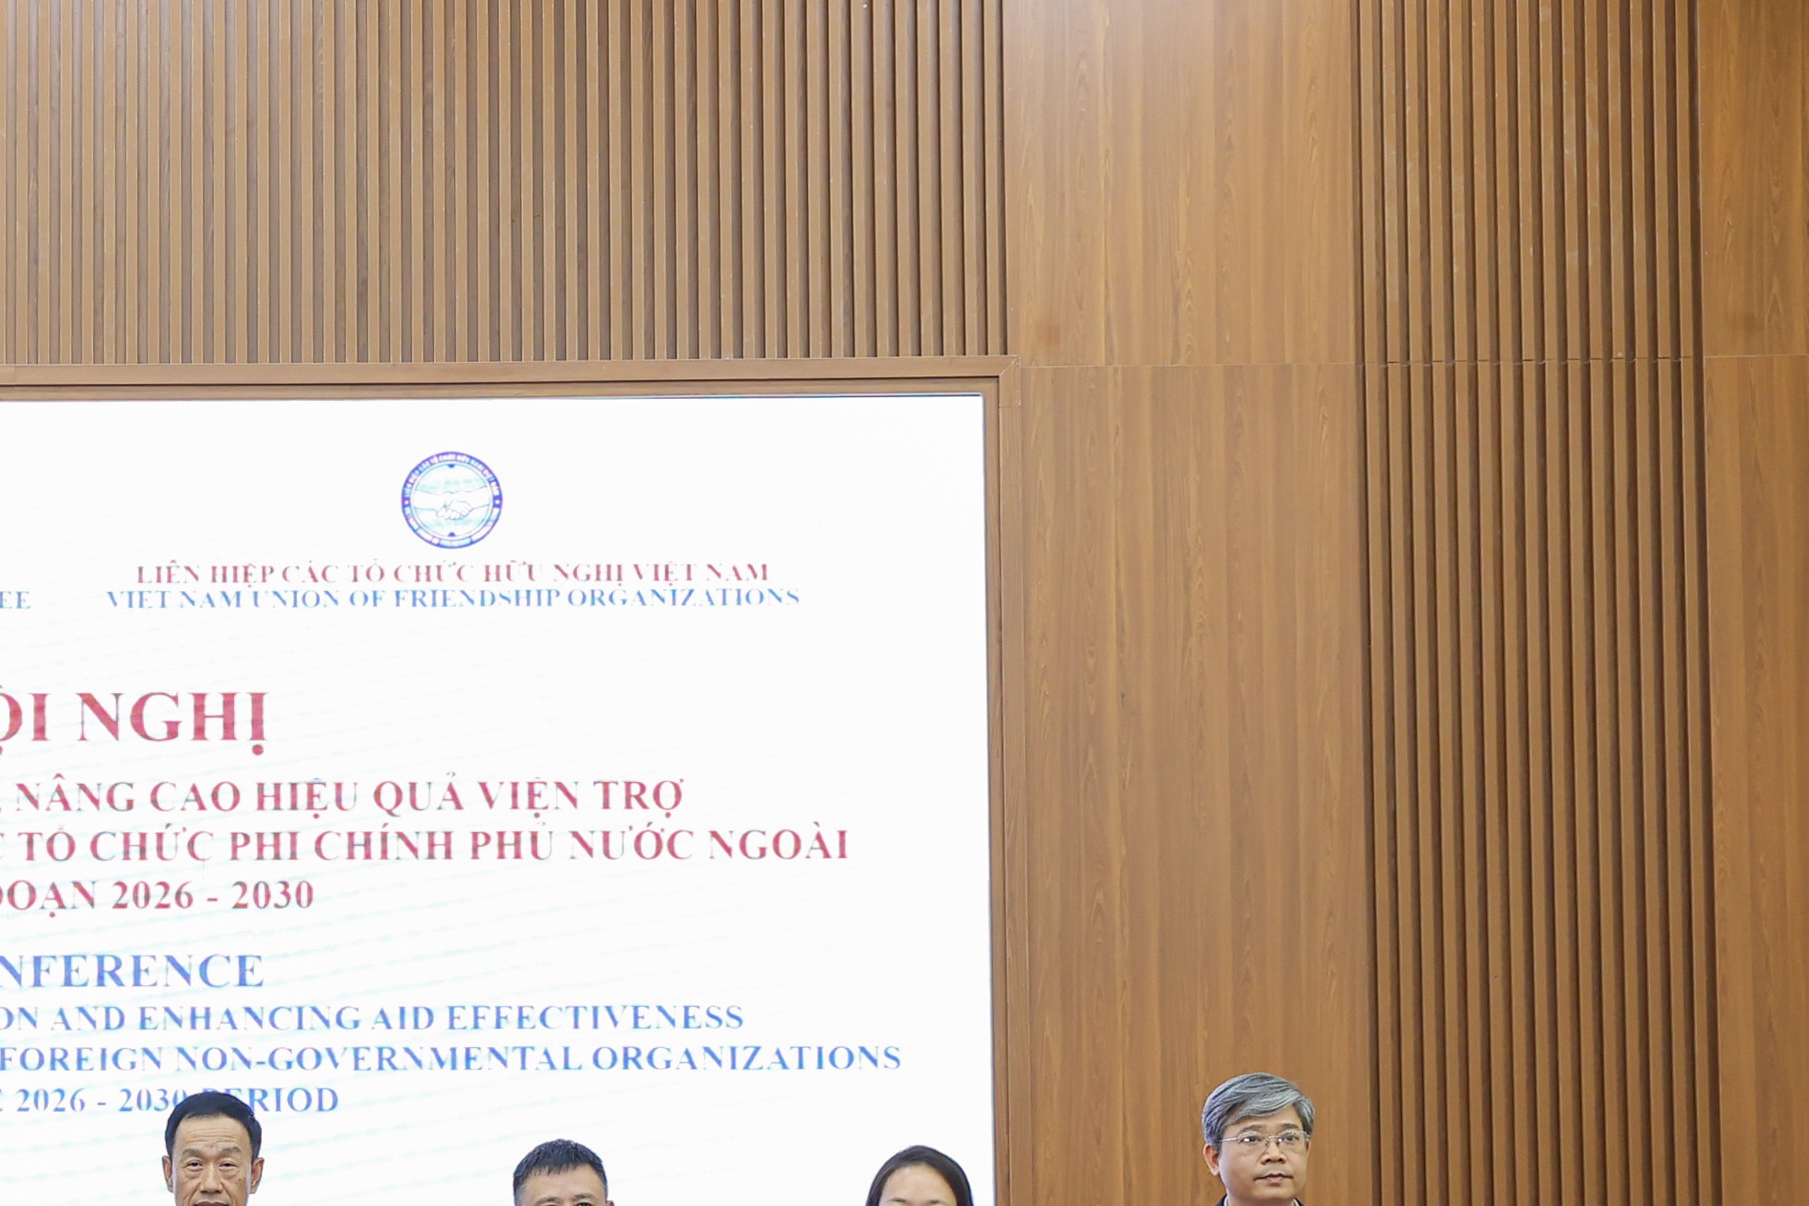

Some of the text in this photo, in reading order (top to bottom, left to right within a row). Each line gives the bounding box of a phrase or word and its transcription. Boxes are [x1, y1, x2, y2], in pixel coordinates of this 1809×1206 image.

[136, 559, 200, 584] LIÊN
[210, 562, 275, 588] HIỆP
[282, 560, 339, 584] CÁC
[393, 558, 473, 583] CHỨC
[553, 563, 623, 586] NGHỊ
[704, 563, 770, 582] NAM
[179, 590, 242, 609] NAM
[252, 590, 340, 608] UNION
[348, 590, 386, 608] OF
[393, 589, 561, 608] FRIENDSHIP
[567, 588, 801, 607] ORGANIZATIONS
[76, 692, 269, 757] NGHỊ
[15, 773, 135, 812] NÂNG
[149, 781, 242, 812] CAO
[255, 777, 358, 819] HIỆU
[373, 771, 465, 817] QUẢ
[477, 777, 580, 818] VIỆN
[593, 777, 684, 818] TRỢ
[17, 823, 75, 861] TỔ
[89, 822, 214, 861] CHỨC
[229, 831, 300, 860] PHI
[314, 822, 454, 861] CHÍNH
[470, 821, 554, 860] PHỦ
[569, 820, 693, 860] NƯỚC
[708, 821, 849, 860] NGOÀI
[112, 880, 194, 909] 2026
[231, 880, 314, 909] 2030
[50, 1006, 126, 1032] AND
[139, 1005, 362, 1031] ENHANCING
[370, 1005, 436, 1031] AID
[446, 1004, 744, 1031] EFFECTIVENESS
[176, 1046, 583, 1072] NON-GOVERNMENTAL
[592, 1045, 902, 1071] ORGANIZATIONS
[16, 1087, 87, 1113] 2026
